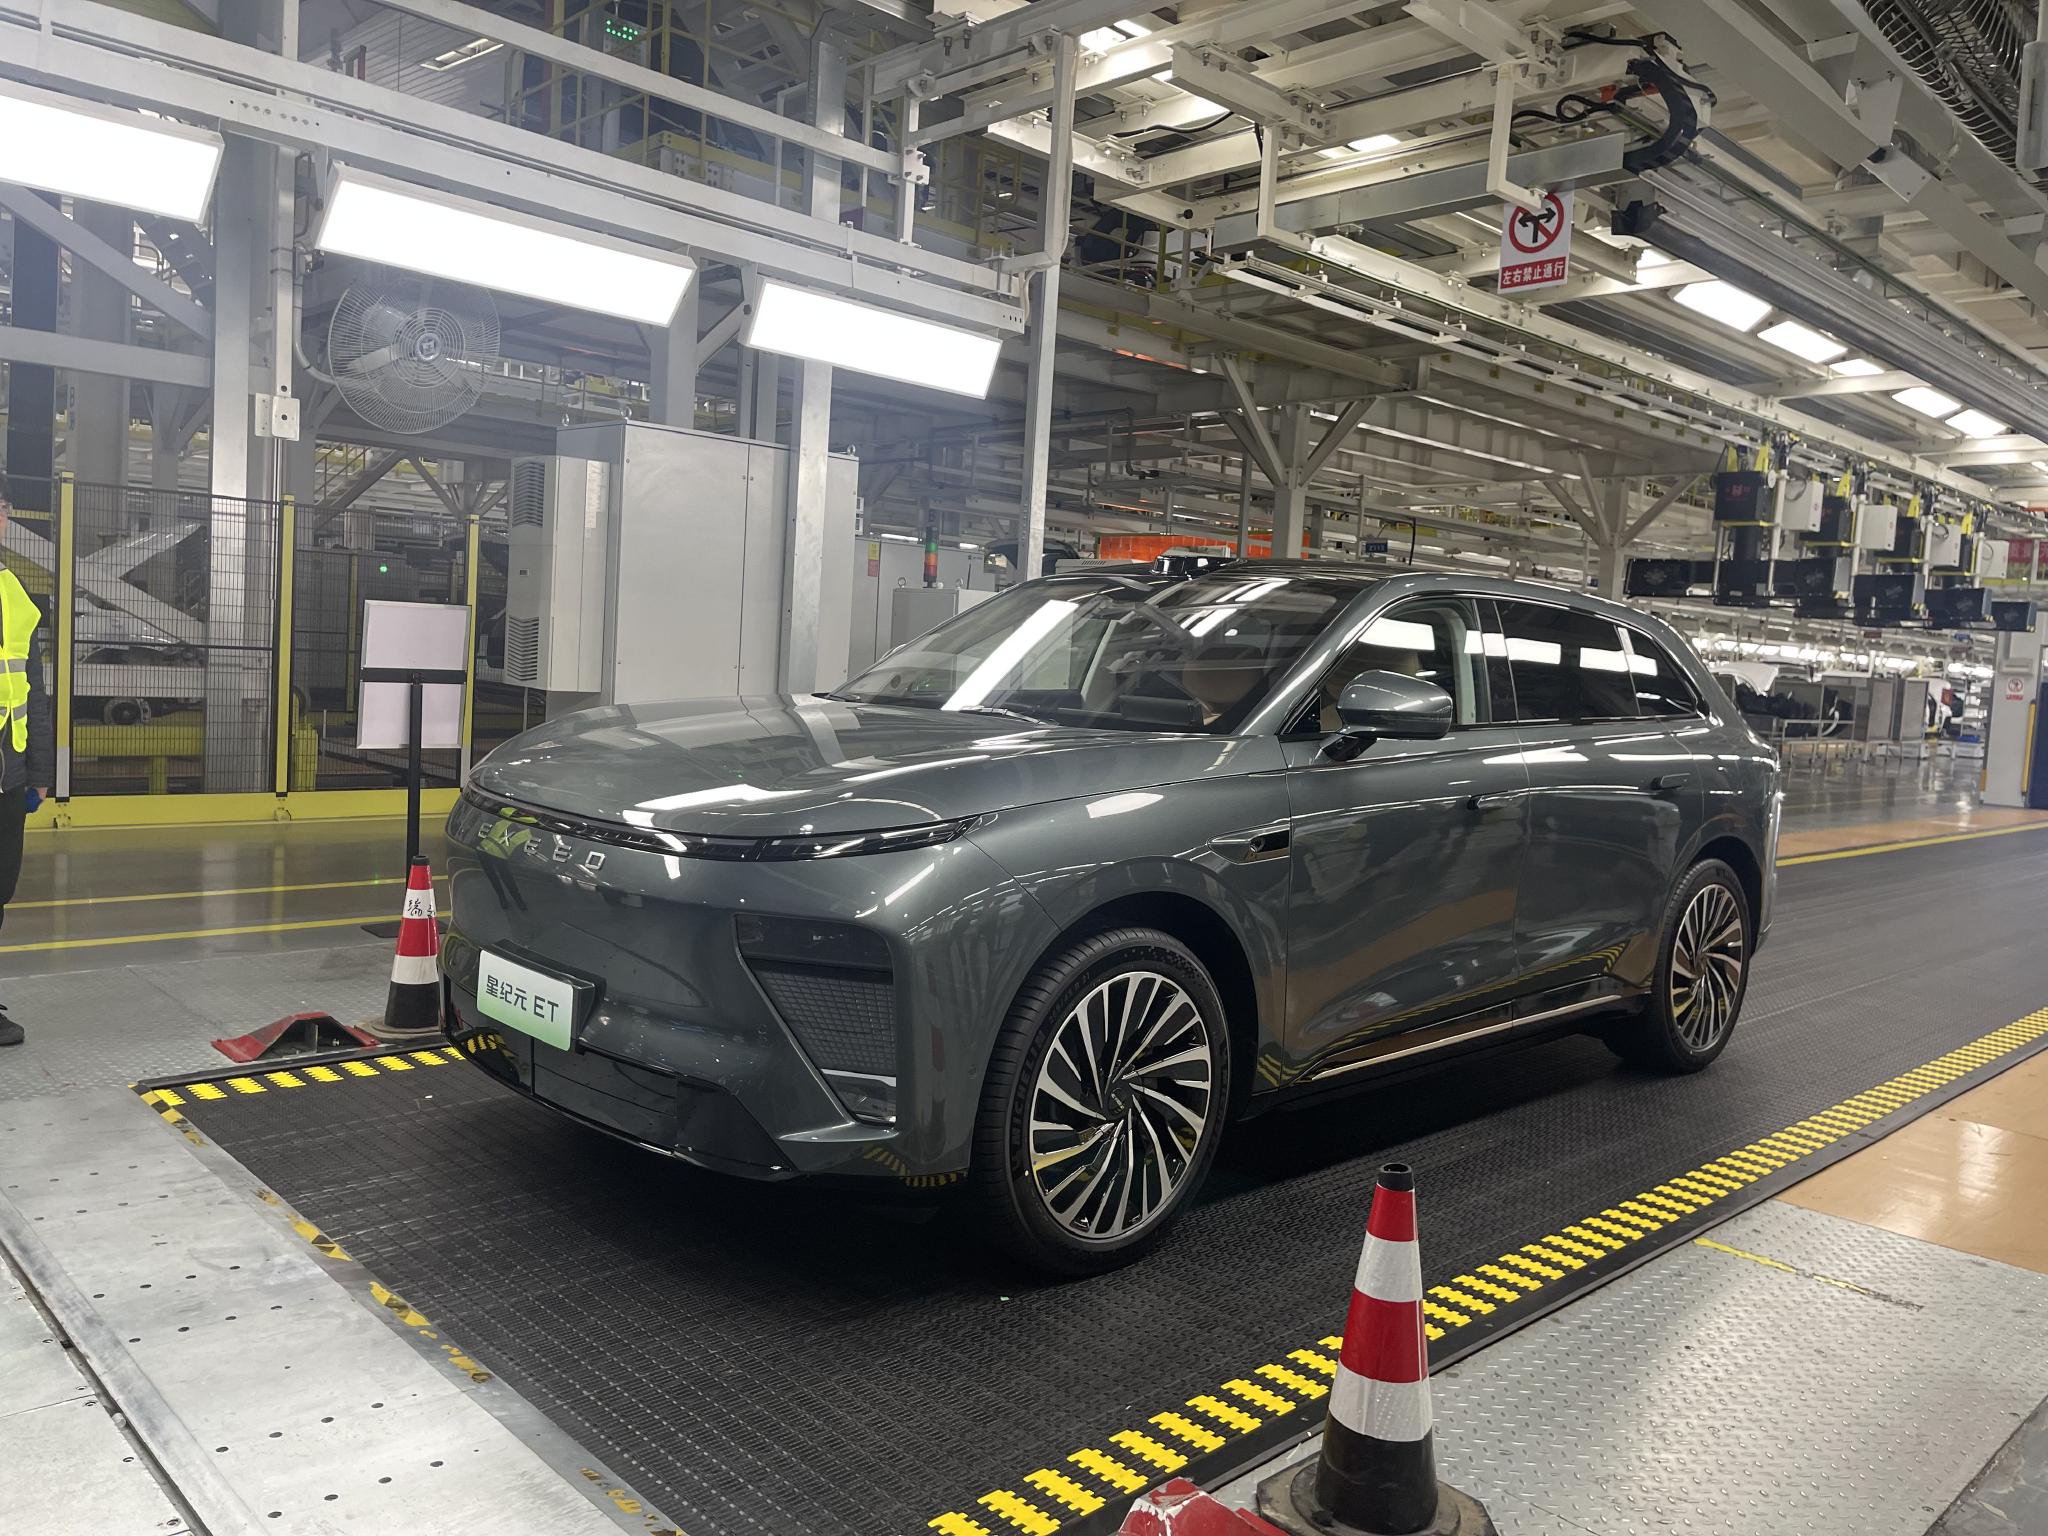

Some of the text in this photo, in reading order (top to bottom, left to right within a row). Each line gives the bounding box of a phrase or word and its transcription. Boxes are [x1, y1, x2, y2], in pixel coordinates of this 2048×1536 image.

[1502, 261, 1564, 285] 左右禁止通行
[485, 974, 559, 1023] 星纪元 ET
